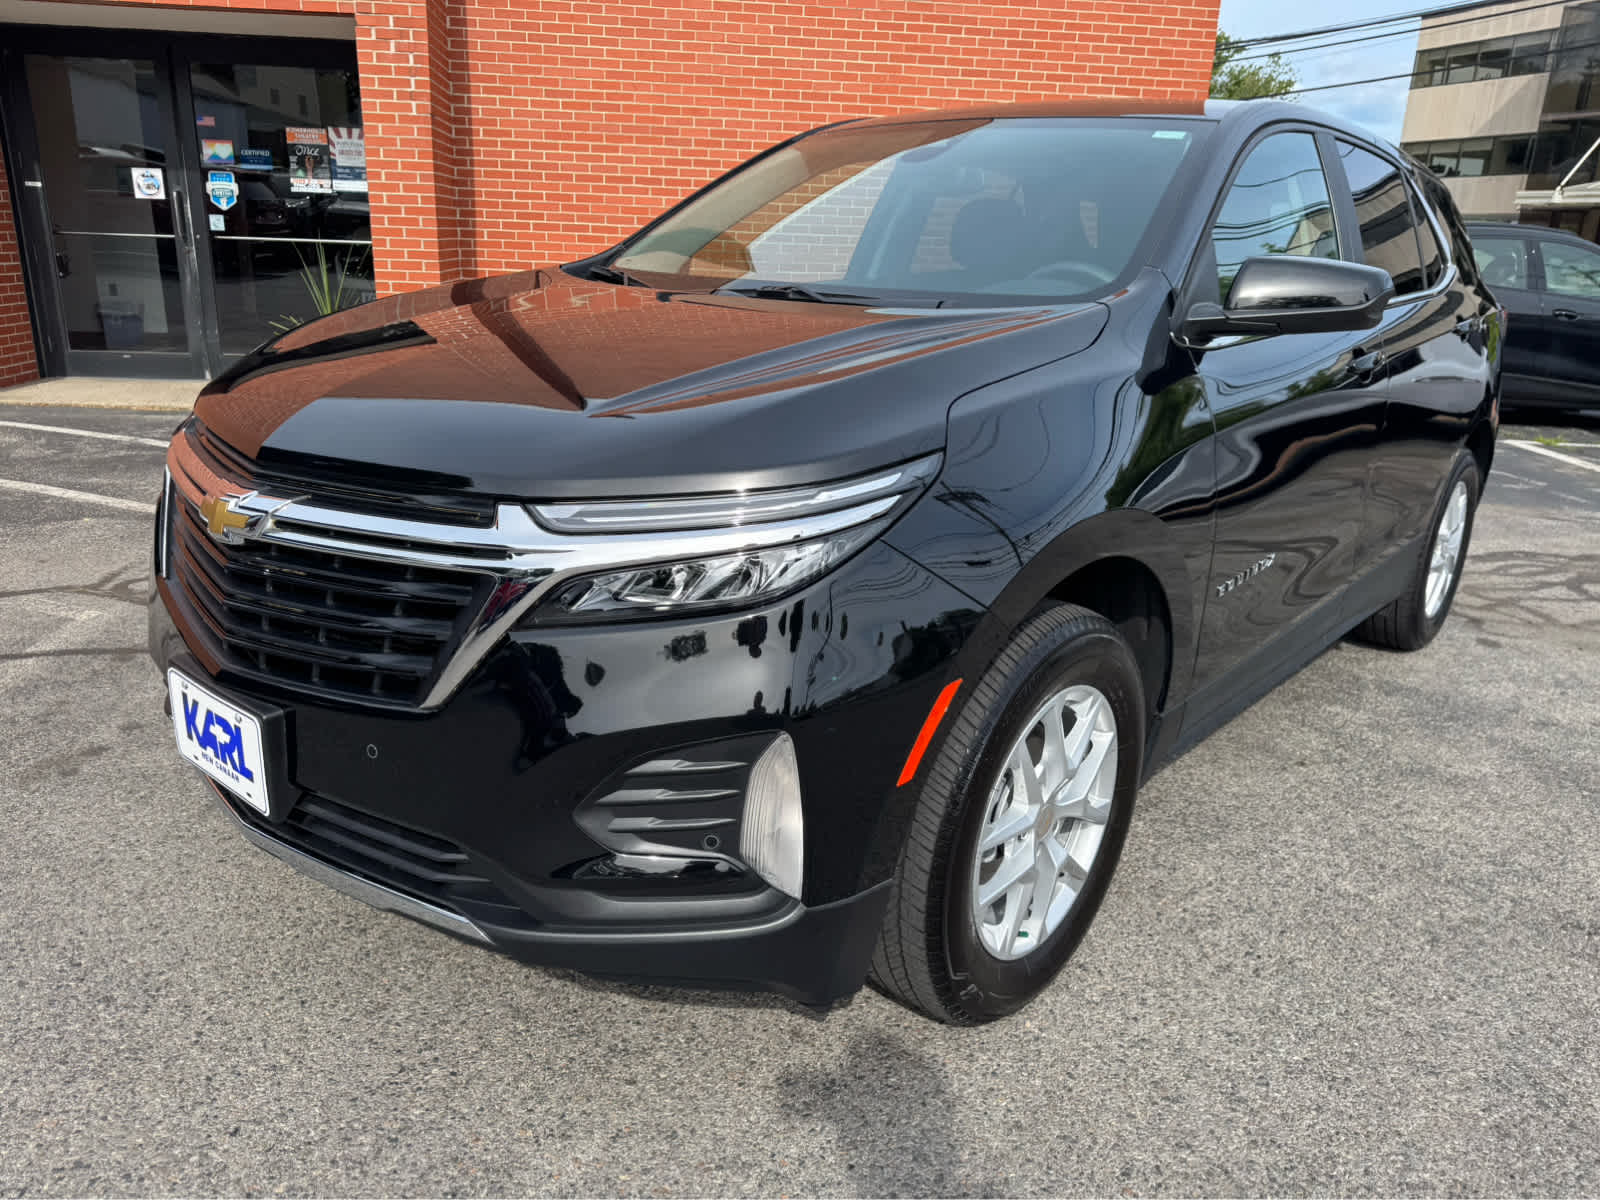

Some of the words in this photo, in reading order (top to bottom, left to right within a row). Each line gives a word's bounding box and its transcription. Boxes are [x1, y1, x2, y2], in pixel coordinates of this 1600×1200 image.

[296, 145, 320, 155] Once
[182, 692, 254, 783] KARL
[215, 761, 240, 782] CANAAN
